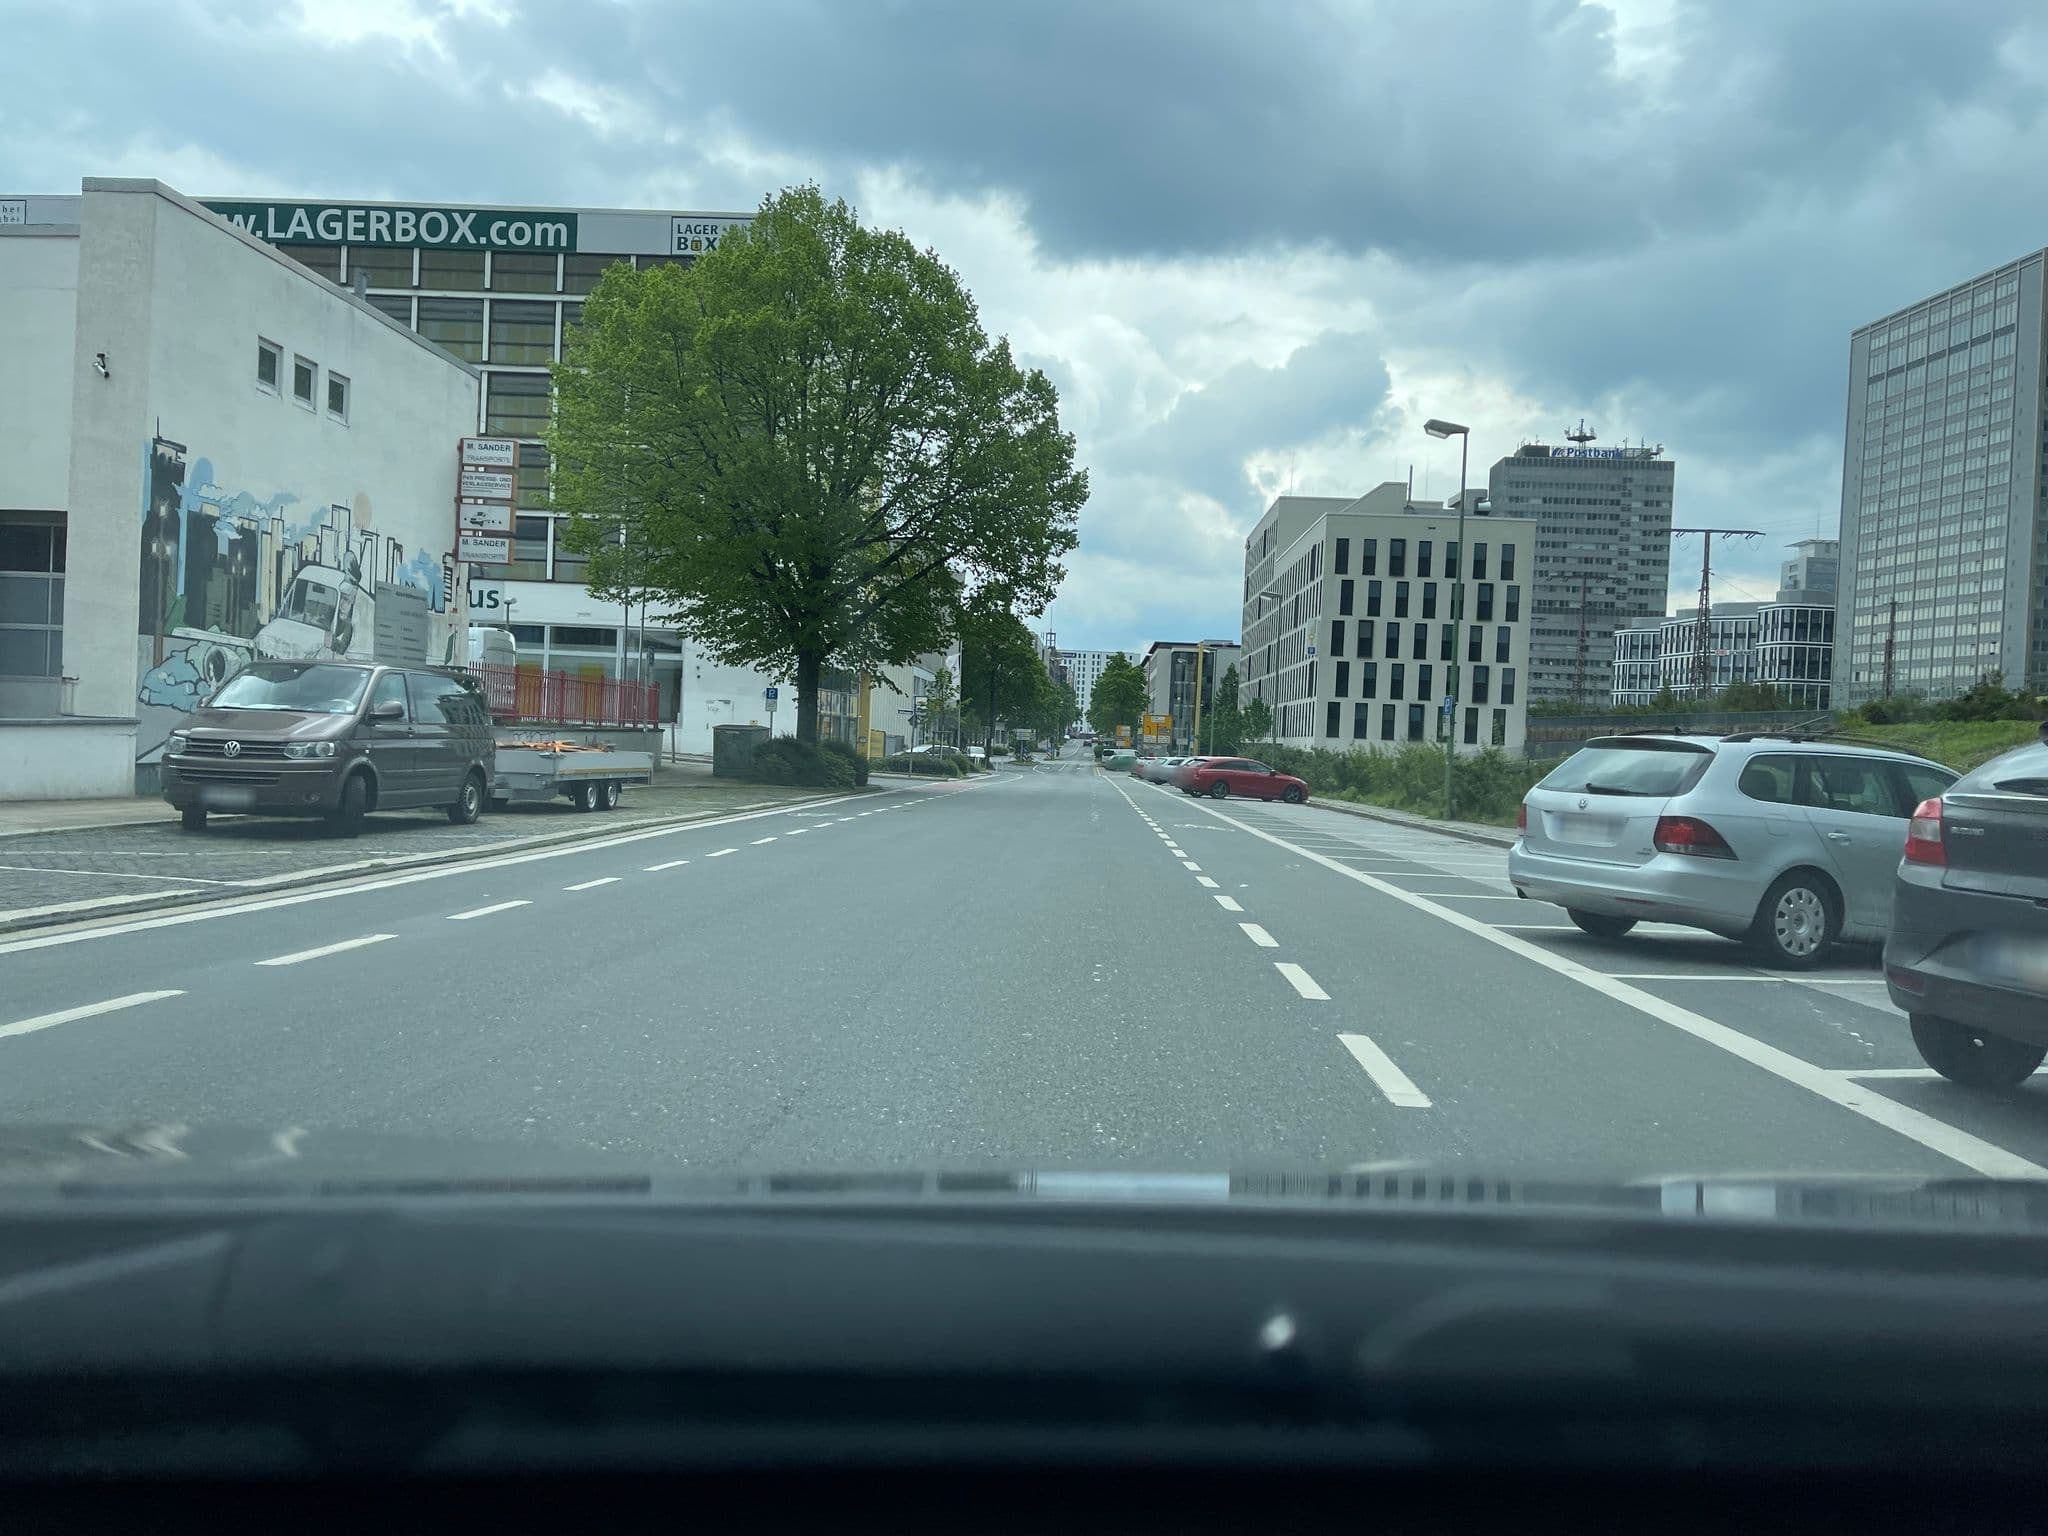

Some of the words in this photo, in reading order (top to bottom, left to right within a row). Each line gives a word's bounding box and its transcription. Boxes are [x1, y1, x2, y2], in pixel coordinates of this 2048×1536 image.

[677, 223, 719, 235] LAGER
[478, 443, 511, 452] SANDER
[1566, 447, 1625, 459] Postbank
[473, 539, 506, 548] SANDER
[469, 589, 499, 609] us
